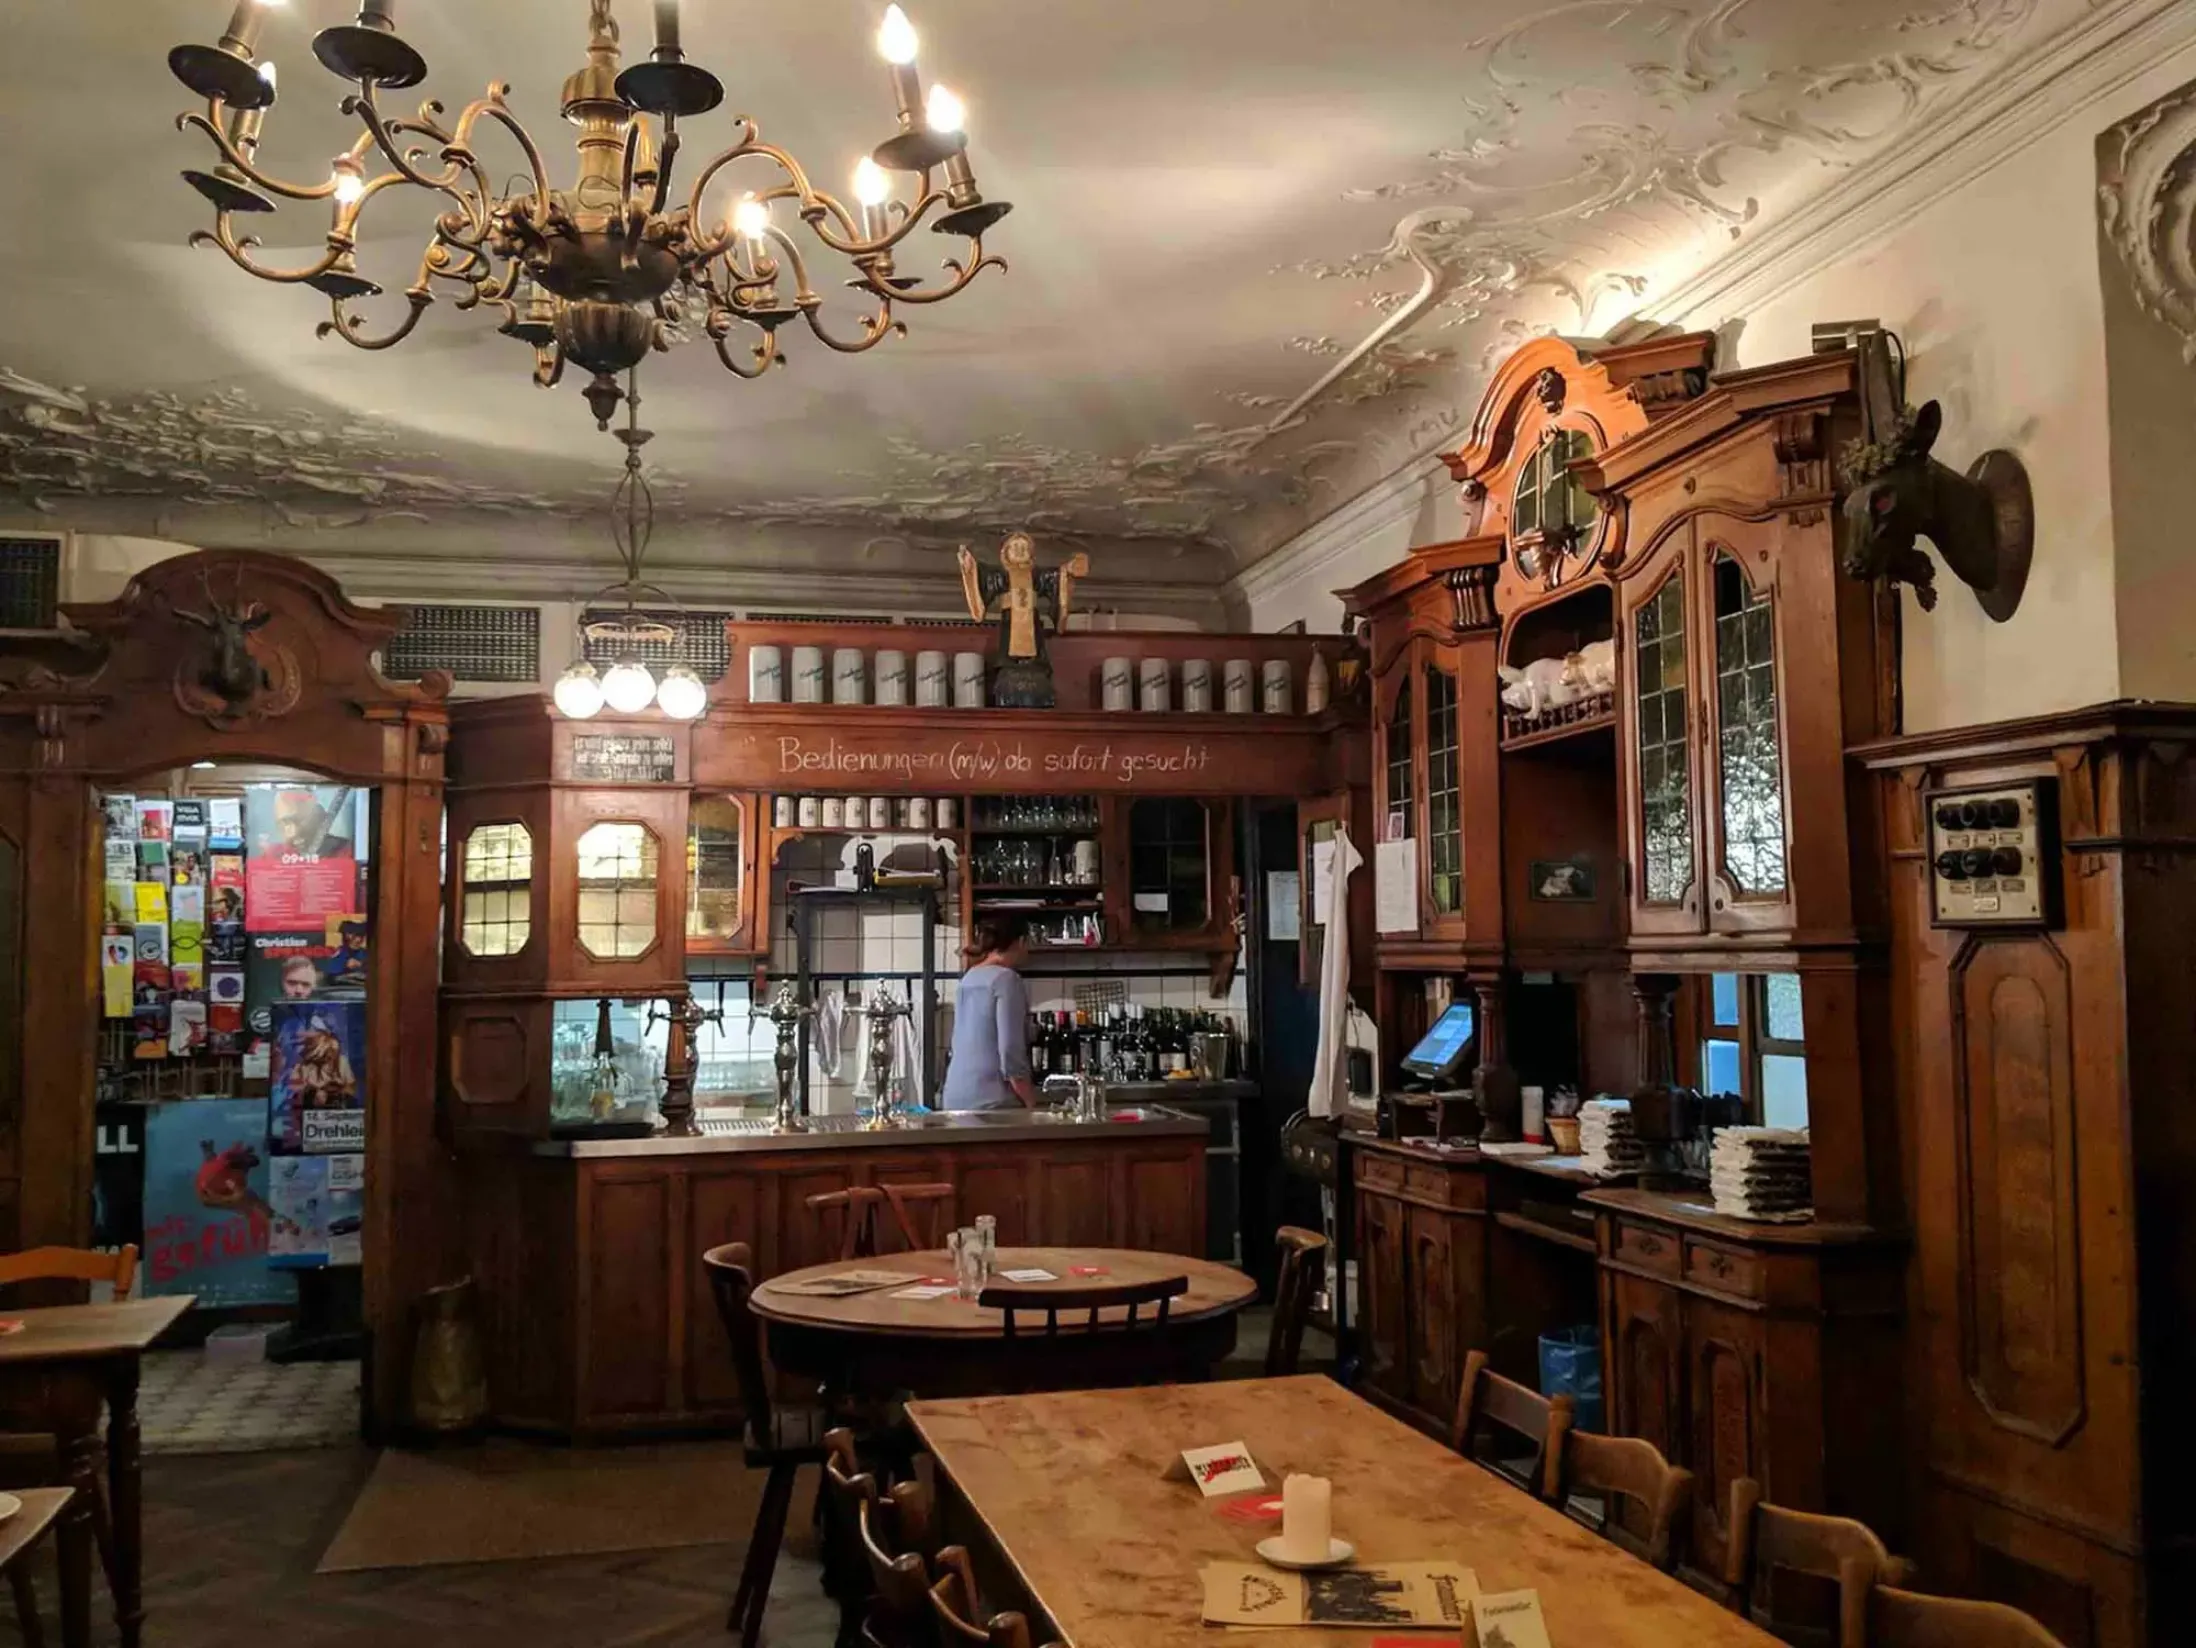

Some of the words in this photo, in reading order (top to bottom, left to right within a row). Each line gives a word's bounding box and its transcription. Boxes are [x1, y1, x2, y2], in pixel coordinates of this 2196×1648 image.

[777, 736, 944, 781] Bedienungen
[948, 740, 1001, 781] (m/w)
[1044, 744, 1114, 772] sofort
[1118, 745, 1212, 782] gesucht
[255, 936, 307, 949] Christian
